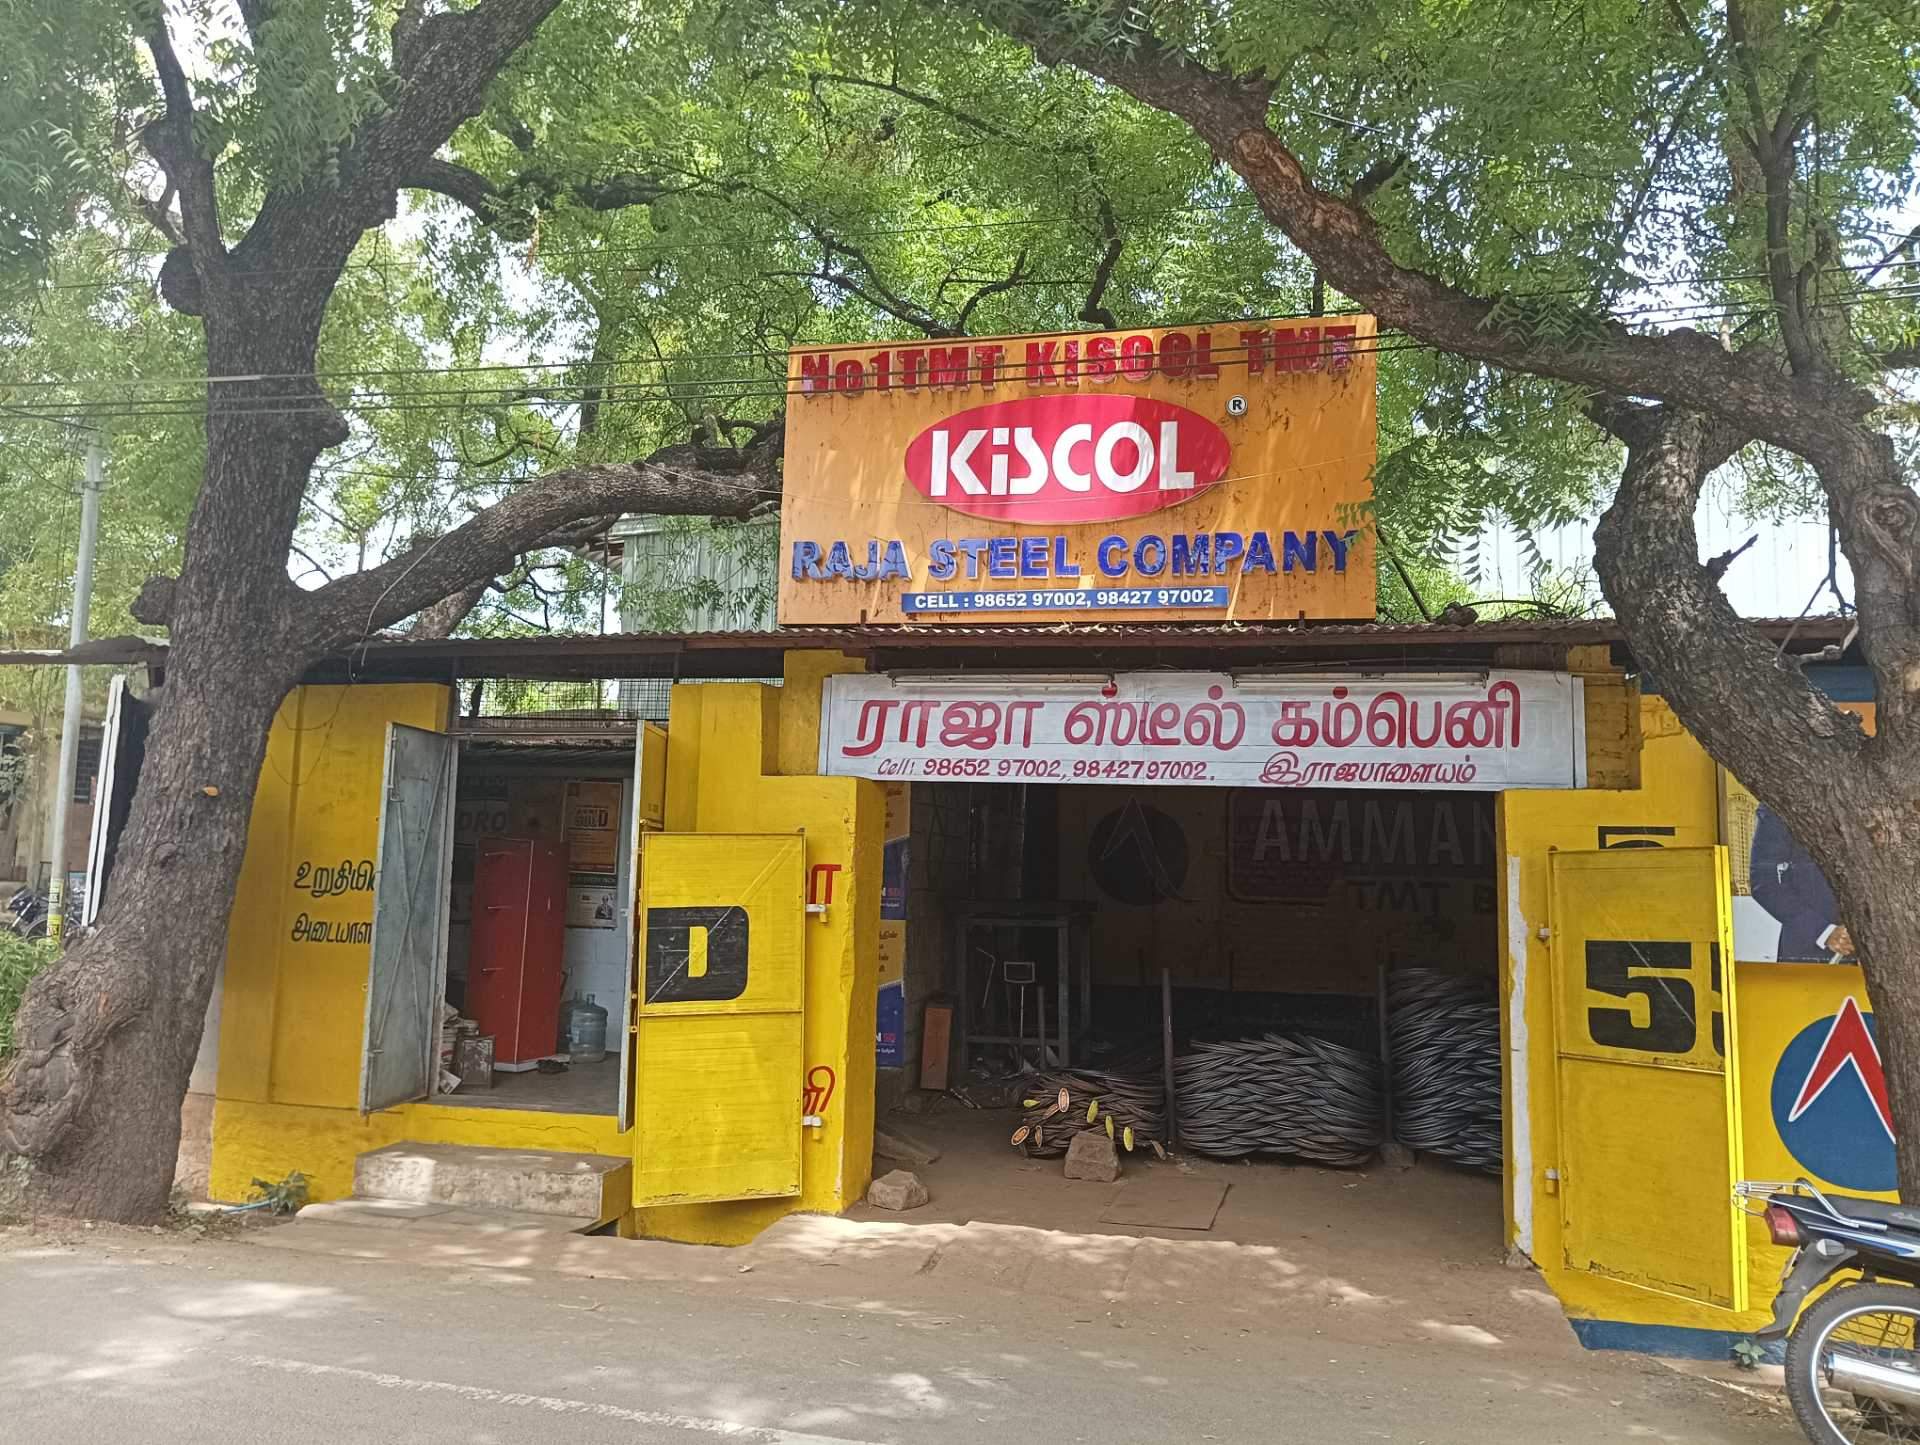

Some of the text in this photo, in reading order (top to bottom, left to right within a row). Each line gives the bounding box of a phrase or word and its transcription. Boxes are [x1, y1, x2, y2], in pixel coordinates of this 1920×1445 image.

[1239, 324, 1357, 377] TMT
[791, 529, 1358, 583] RAJA STEEL COMPANY
[915, 594, 958, 608] CELL
[974, 593, 1027, 607] 98652
[1032, 591, 1092, 608] 97002,
[1096, 590, 1152, 605] 98427
[1157, 589, 1214, 604] 97002
[842, 680, 1521, 757] ராஜா ஸ்டீல் கம்பெனி
[922, 758, 990, 777] 98652
[1258, 750, 1477, 787] இராஜபாளையம்
[1584, 939, 1726, 1057] 5
